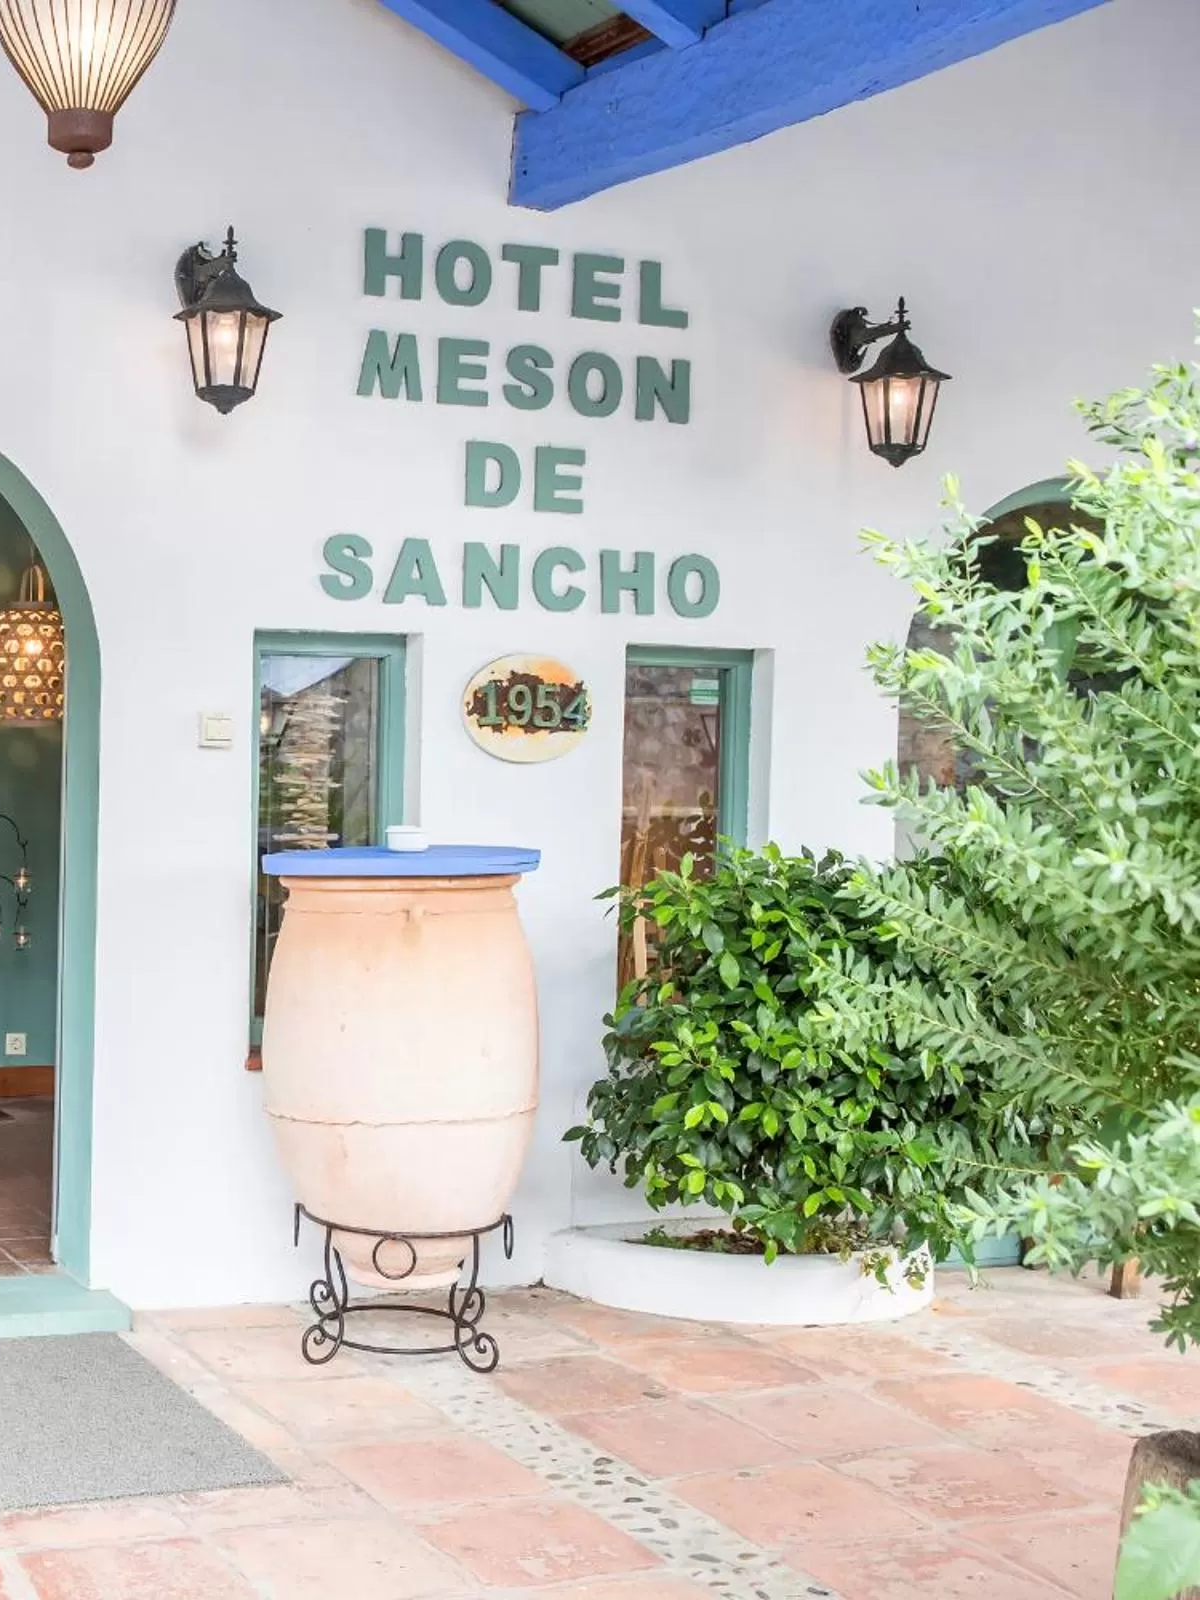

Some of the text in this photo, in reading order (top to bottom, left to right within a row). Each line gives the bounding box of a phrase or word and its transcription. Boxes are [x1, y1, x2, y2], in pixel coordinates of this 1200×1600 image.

[364, 228, 689, 328] HOTEL
[357, 329, 691, 424] MESON
[464, 440, 586, 514] DE
[319, 534, 720, 618] SANCHO
[478, 680, 588, 730] 1954
